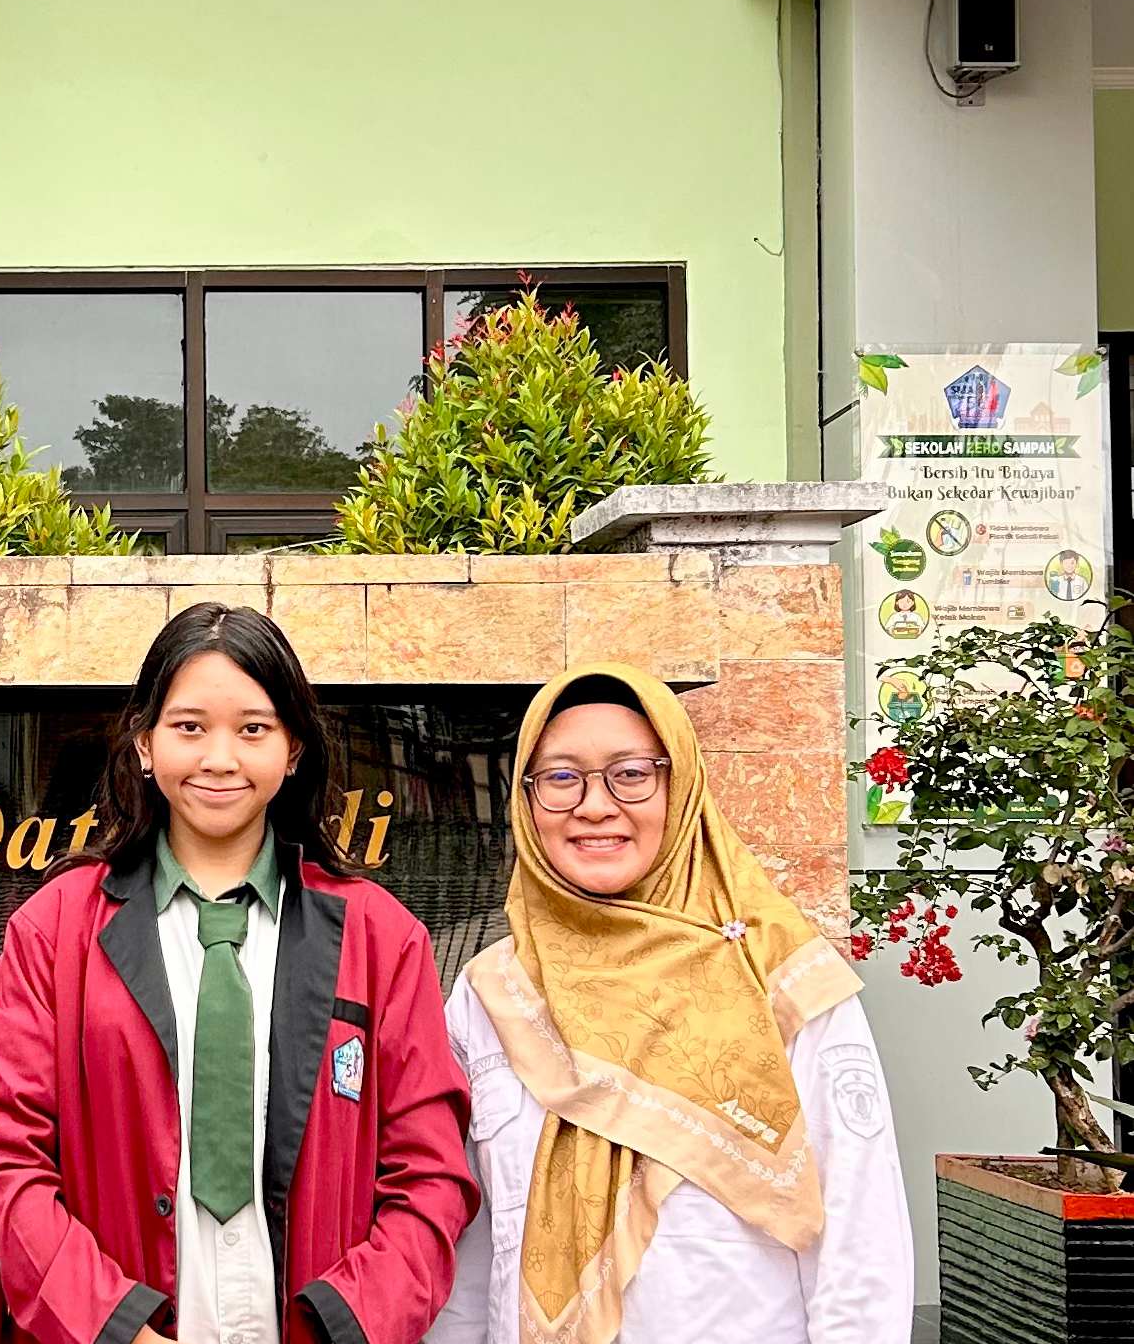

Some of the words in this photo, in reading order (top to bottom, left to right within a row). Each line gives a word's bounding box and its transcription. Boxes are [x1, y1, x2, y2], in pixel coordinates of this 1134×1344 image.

[904, 441, 964, 455] SEKOLAH
[966, 441, 1001, 455] ZERO
[1003, 441, 1055, 455] SAMPAH
[886, 485, 933, 501] Bukan
[937, 485, 995, 501] Sekedar
